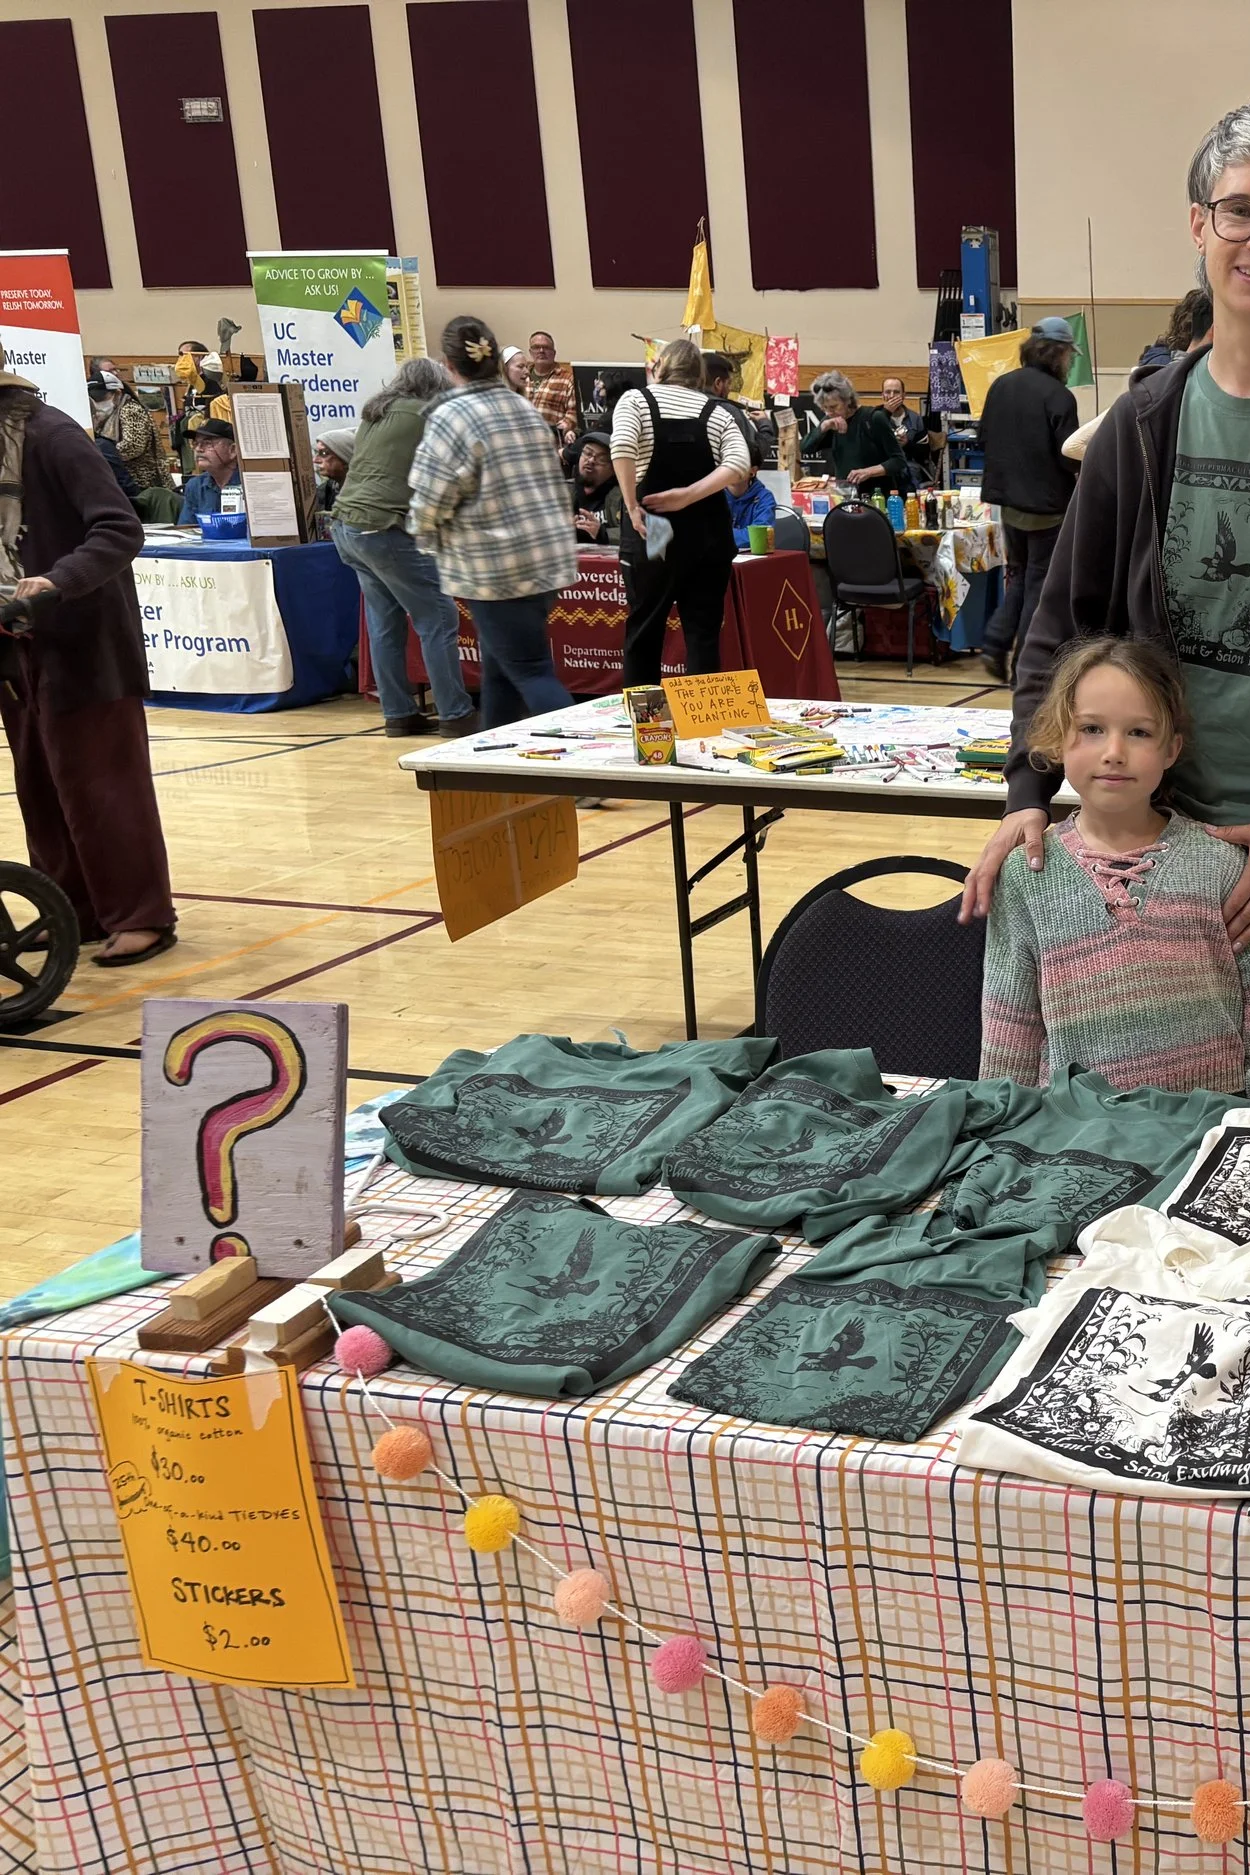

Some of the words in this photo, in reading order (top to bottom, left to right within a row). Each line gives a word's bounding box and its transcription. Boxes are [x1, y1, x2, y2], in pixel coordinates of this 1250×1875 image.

[265, 269, 299, 280] ADVICE
[301, 269, 316, 280] TO
[317, 269, 348, 280] GROW
[351, 268, 362, 279] BY
[1, 289, 29, 299] PRESERVE
[29, 289, 53, 299] TODAY,
[304, 285, 322, 296] ASK
[323, 285, 340, 296] US!
[3, 301, 23, 311] RELISH
[24, 301, 65, 310] TOMORROW.
[273, 322, 297, 340] UC
[4, 350, 47, 365] Master
[276, 348, 334, 366] Master
[155, 574, 165, 586] BY
[180, 576, 197, 588] ASK
[199, 577, 217, 590] US!
[574, 570, 625, 588] overeig
[558, 587, 627, 605] nowledg
[163, 629, 251, 657] Program
[457, 635, 475, 647] Poly
[1180, 643, 1196, 656] ant
[1200, 644, 1213, 657] &
[1216, 650, 1245, 665] Scion
[563, 658, 600, 670] Native
[661, 662, 687, 674] Studi
[669, 678, 682, 688] add
[685, 679, 694, 687] to
[675, 688, 695, 700] THE
[701, 685, 741, 697] FUTURE
[682, 700, 704, 715] YOU
[710, 698, 734, 710] ARE
[640, 733, 672, 743] CRAYONS
[457, 1152, 480, 1166] &
[704, 1171, 727, 1184] &
[729, 1179, 771, 1195] Scion
[134, 1378, 231, 1419] T-SHIRTS
[156, 1426, 193, 1442] organic
[199, 1428, 243, 1440] cotton
[150, 1446, 206, 1484] $30.00
[1095, 1446, 1122, 1461] &
[1124, 1459, 1170, 1483] Scion
[167, 1525, 241, 1553] $40.00
[171, 1577, 286, 1607] STICKERS
[203, 1621, 271, 1651] $2.00
